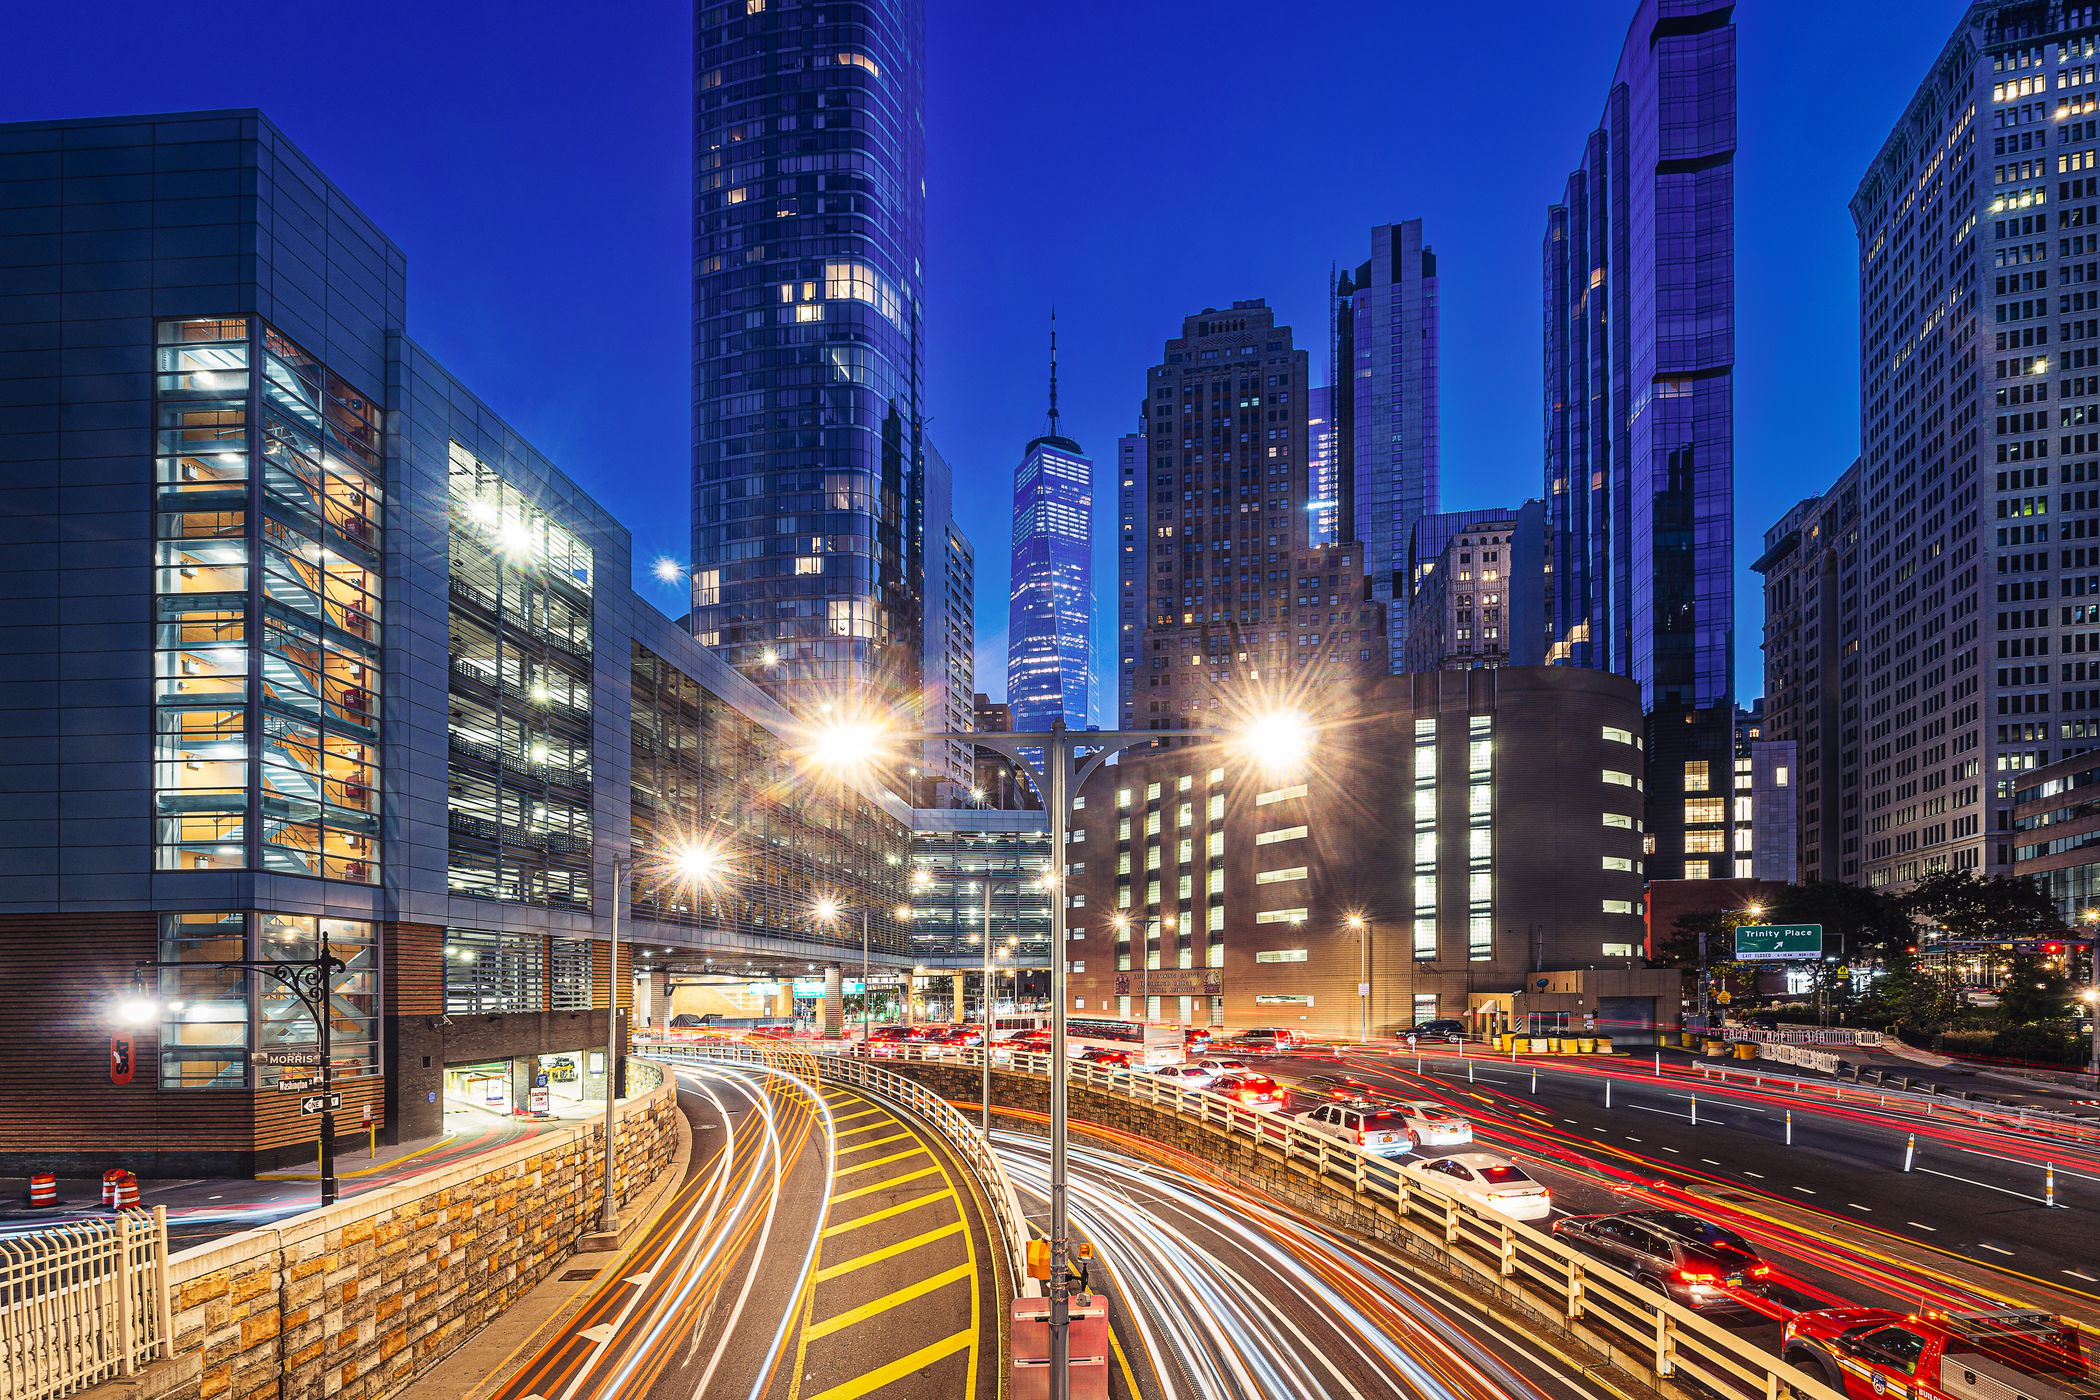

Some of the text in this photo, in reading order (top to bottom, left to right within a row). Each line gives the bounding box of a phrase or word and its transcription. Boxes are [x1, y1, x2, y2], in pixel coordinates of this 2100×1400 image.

[1745, 929, 1812, 938] Trinity Place
[269, 1055, 313, 1064] MORRIS
[279, 1080, 308, 1092] Washington
[307, 1100, 320, 1109] ONE
